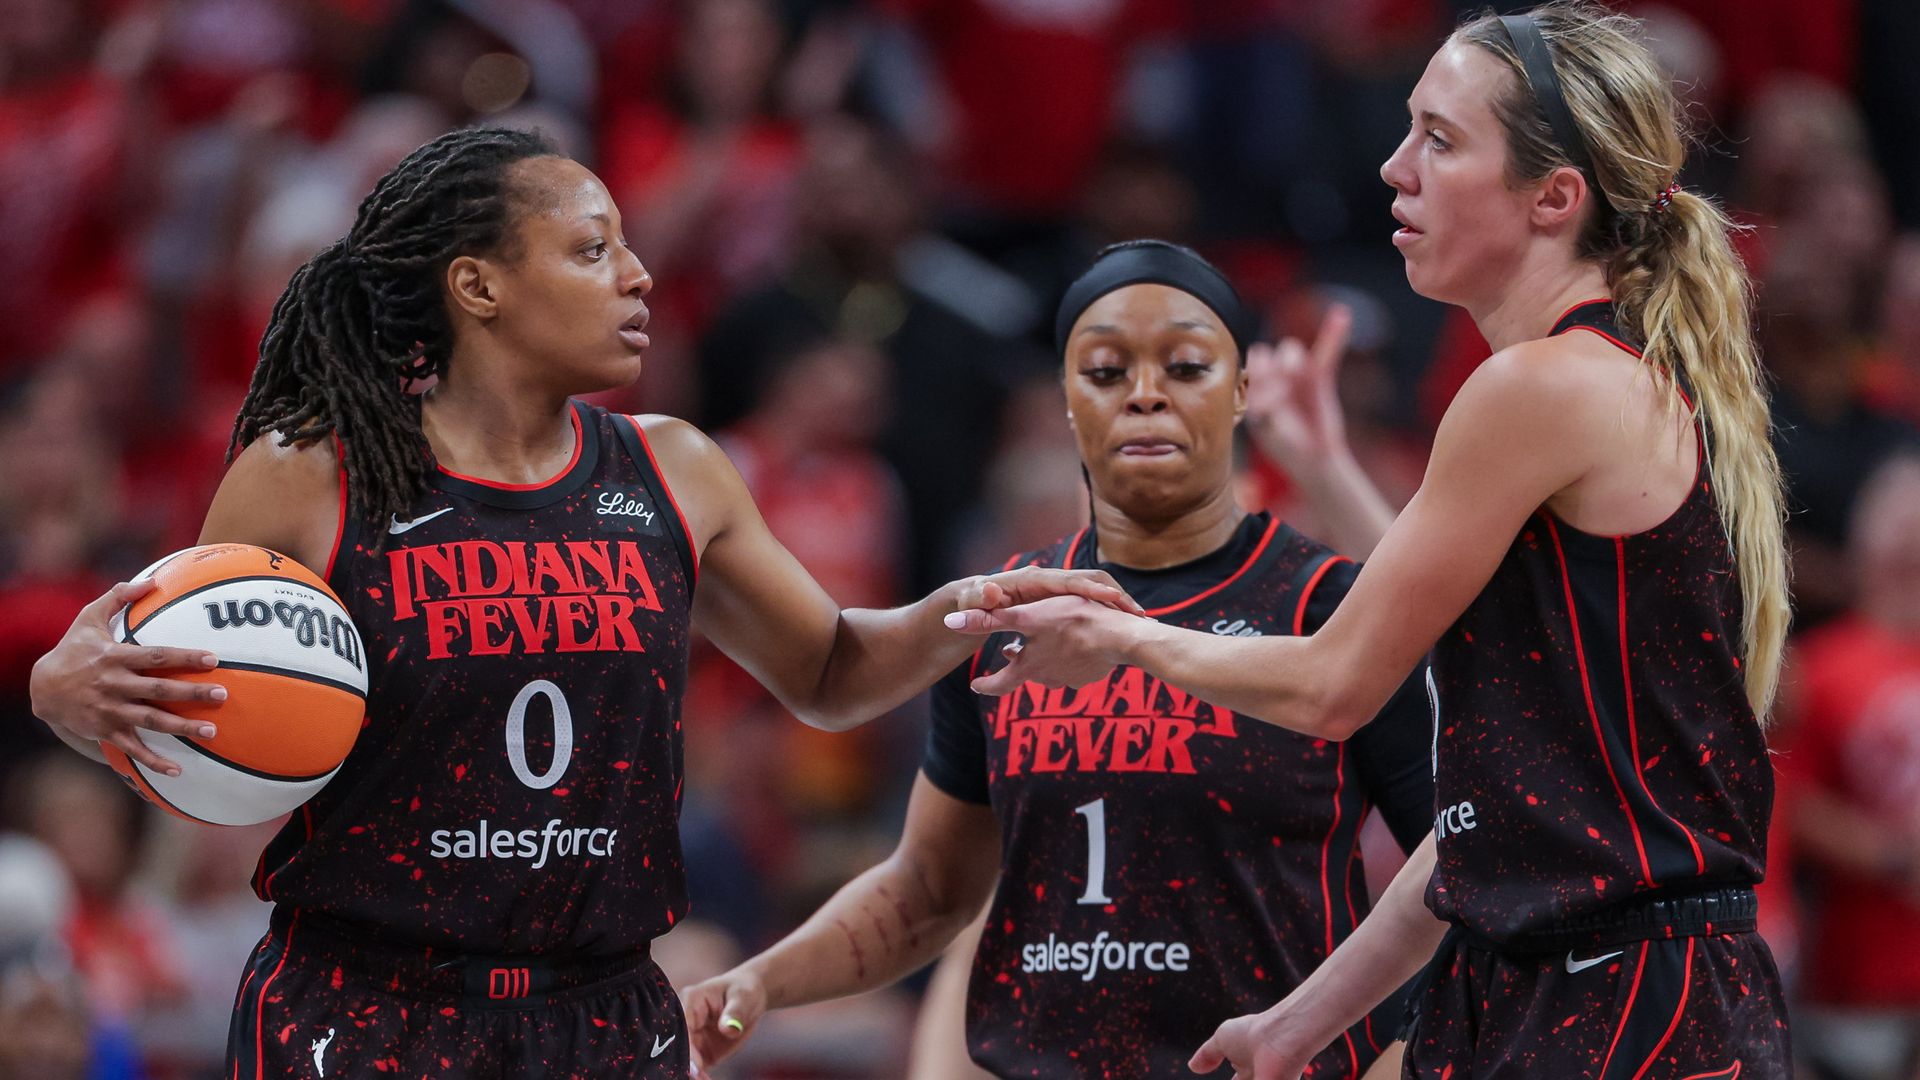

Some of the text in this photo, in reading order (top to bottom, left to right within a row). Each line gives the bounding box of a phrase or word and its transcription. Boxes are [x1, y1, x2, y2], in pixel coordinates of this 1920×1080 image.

[597, 491, 655, 526] Lilly
[386, 540, 664, 621] INDIANA
[203, 599, 363, 673] Wilson
[422, 594, 646, 660] FEVER
[505, 679, 574, 790] 0
[1005, 716, 1198, 777] FEVER
[1075, 797, 1112, 904] 1
[1022, 931, 1190, 981] salesforce
